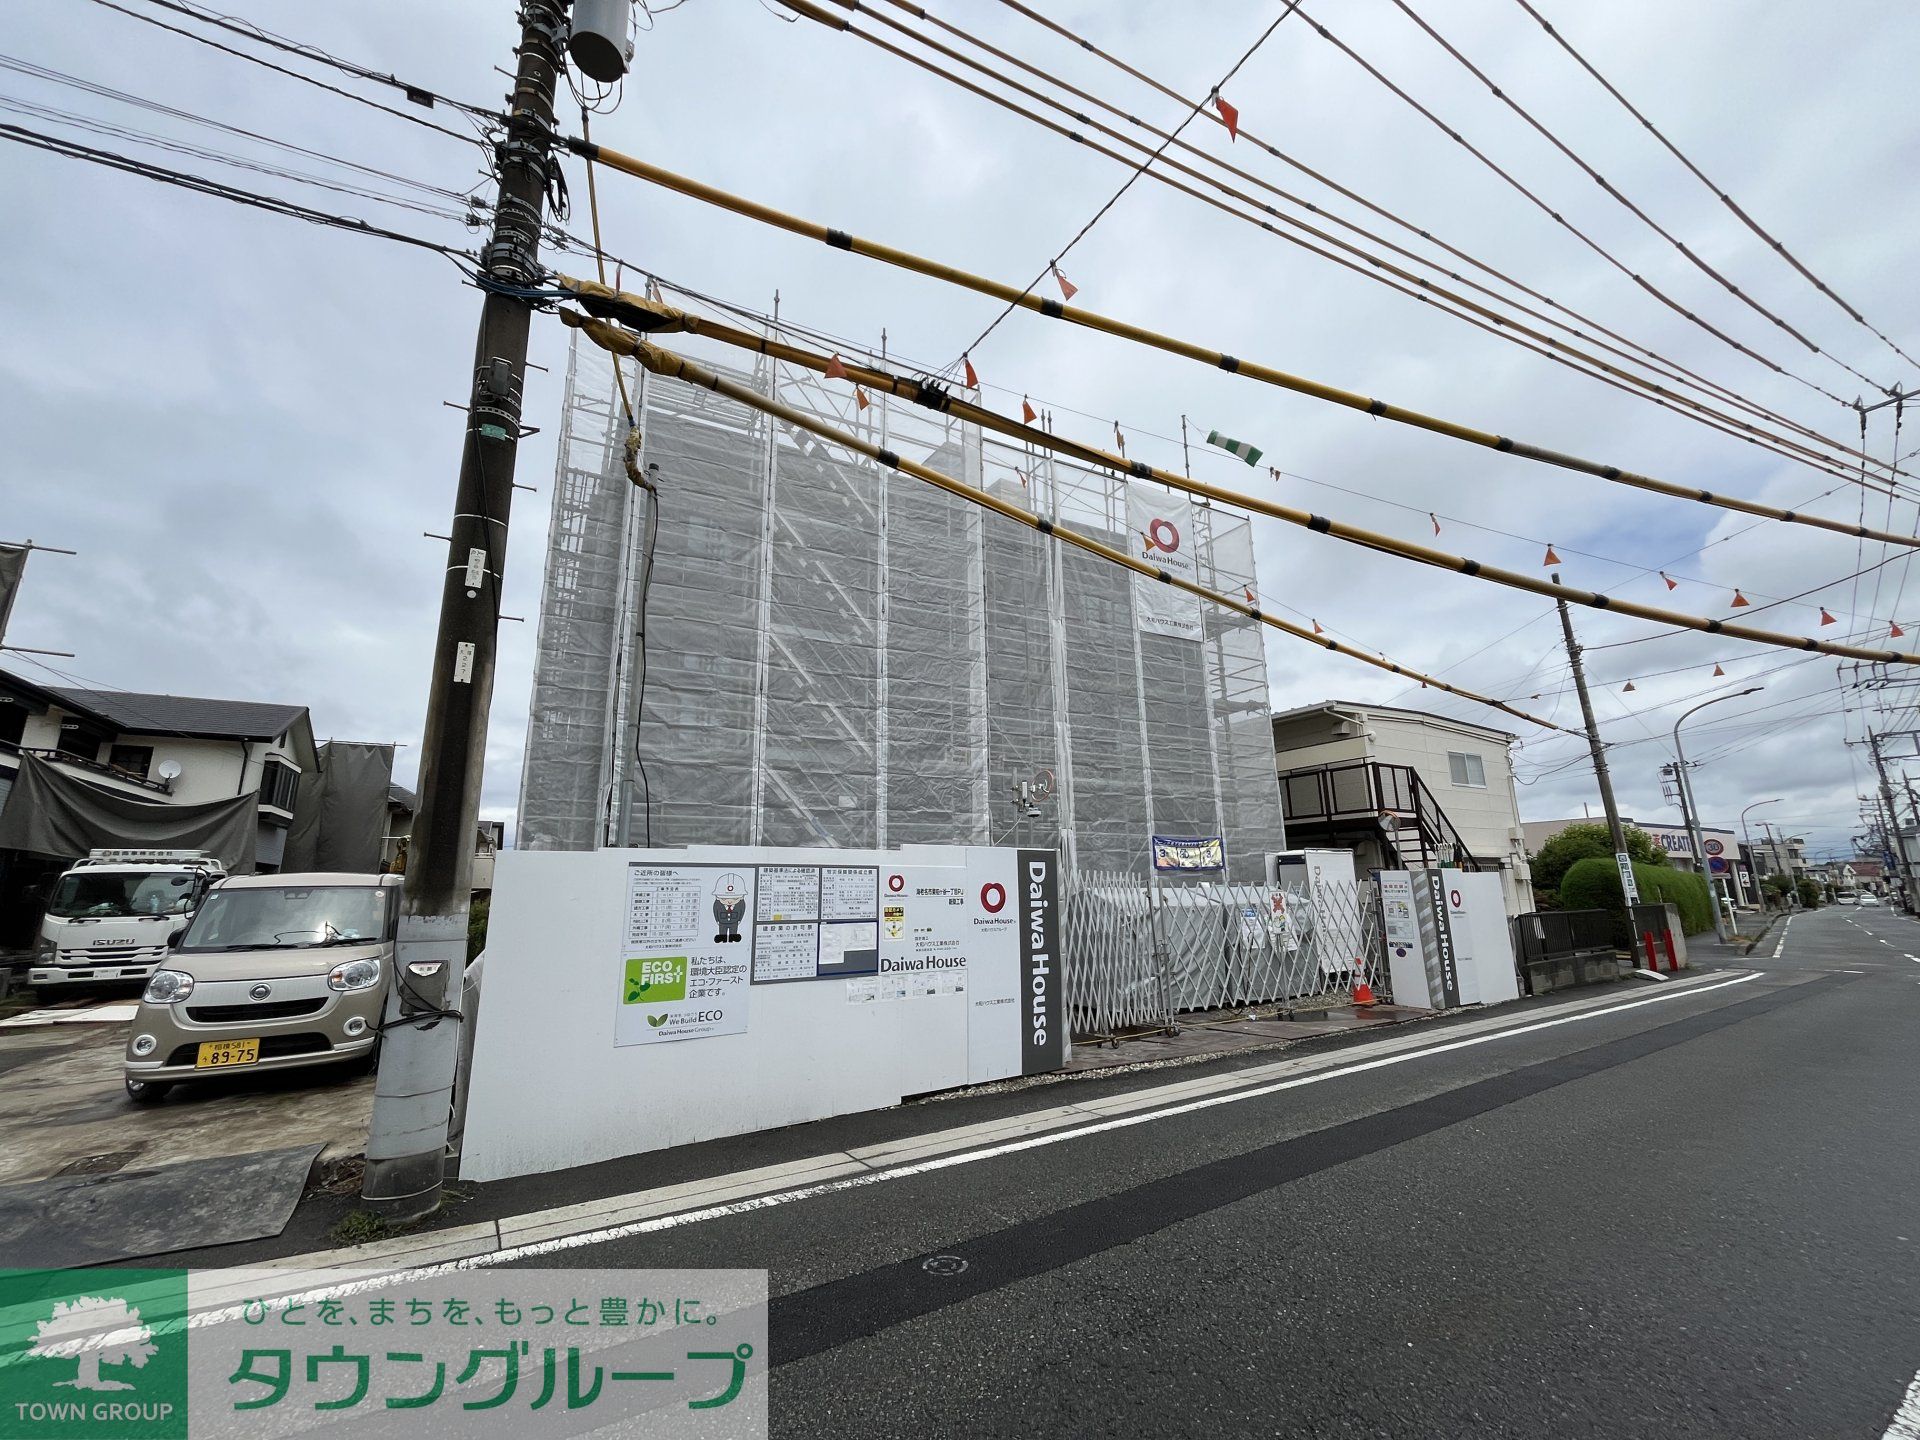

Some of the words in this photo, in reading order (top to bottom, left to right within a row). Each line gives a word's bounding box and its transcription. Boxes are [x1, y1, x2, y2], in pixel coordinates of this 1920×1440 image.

[1142, 552, 1166, 563] Daiwa
[1167, 556, 1188, 569] House
[1708, 843, 1720, 851] 30
[1030, 862, 1048, 950] Daiwa
[1432, 876, 1445, 932] Daiwa
[1440, 934, 1453, 991] House
[641, 961, 672, 973] ECO
[690, 956, 726, 965] 私たちは、
[880, 956, 924, 972] Daiwa
[926, 955, 966, 969] House
[641, 966, 683, 985] FIRST
[690, 965, 747, 976] 環境大臣認定の
[689, 988, 726, 998] 企業です。
[1032, 954, 1050, 1046] House
[698, 1010, 723, 1022] ECO
[231, 1041, 245, 1049] 581
[211, 1049, 255, 1064] 89-75
